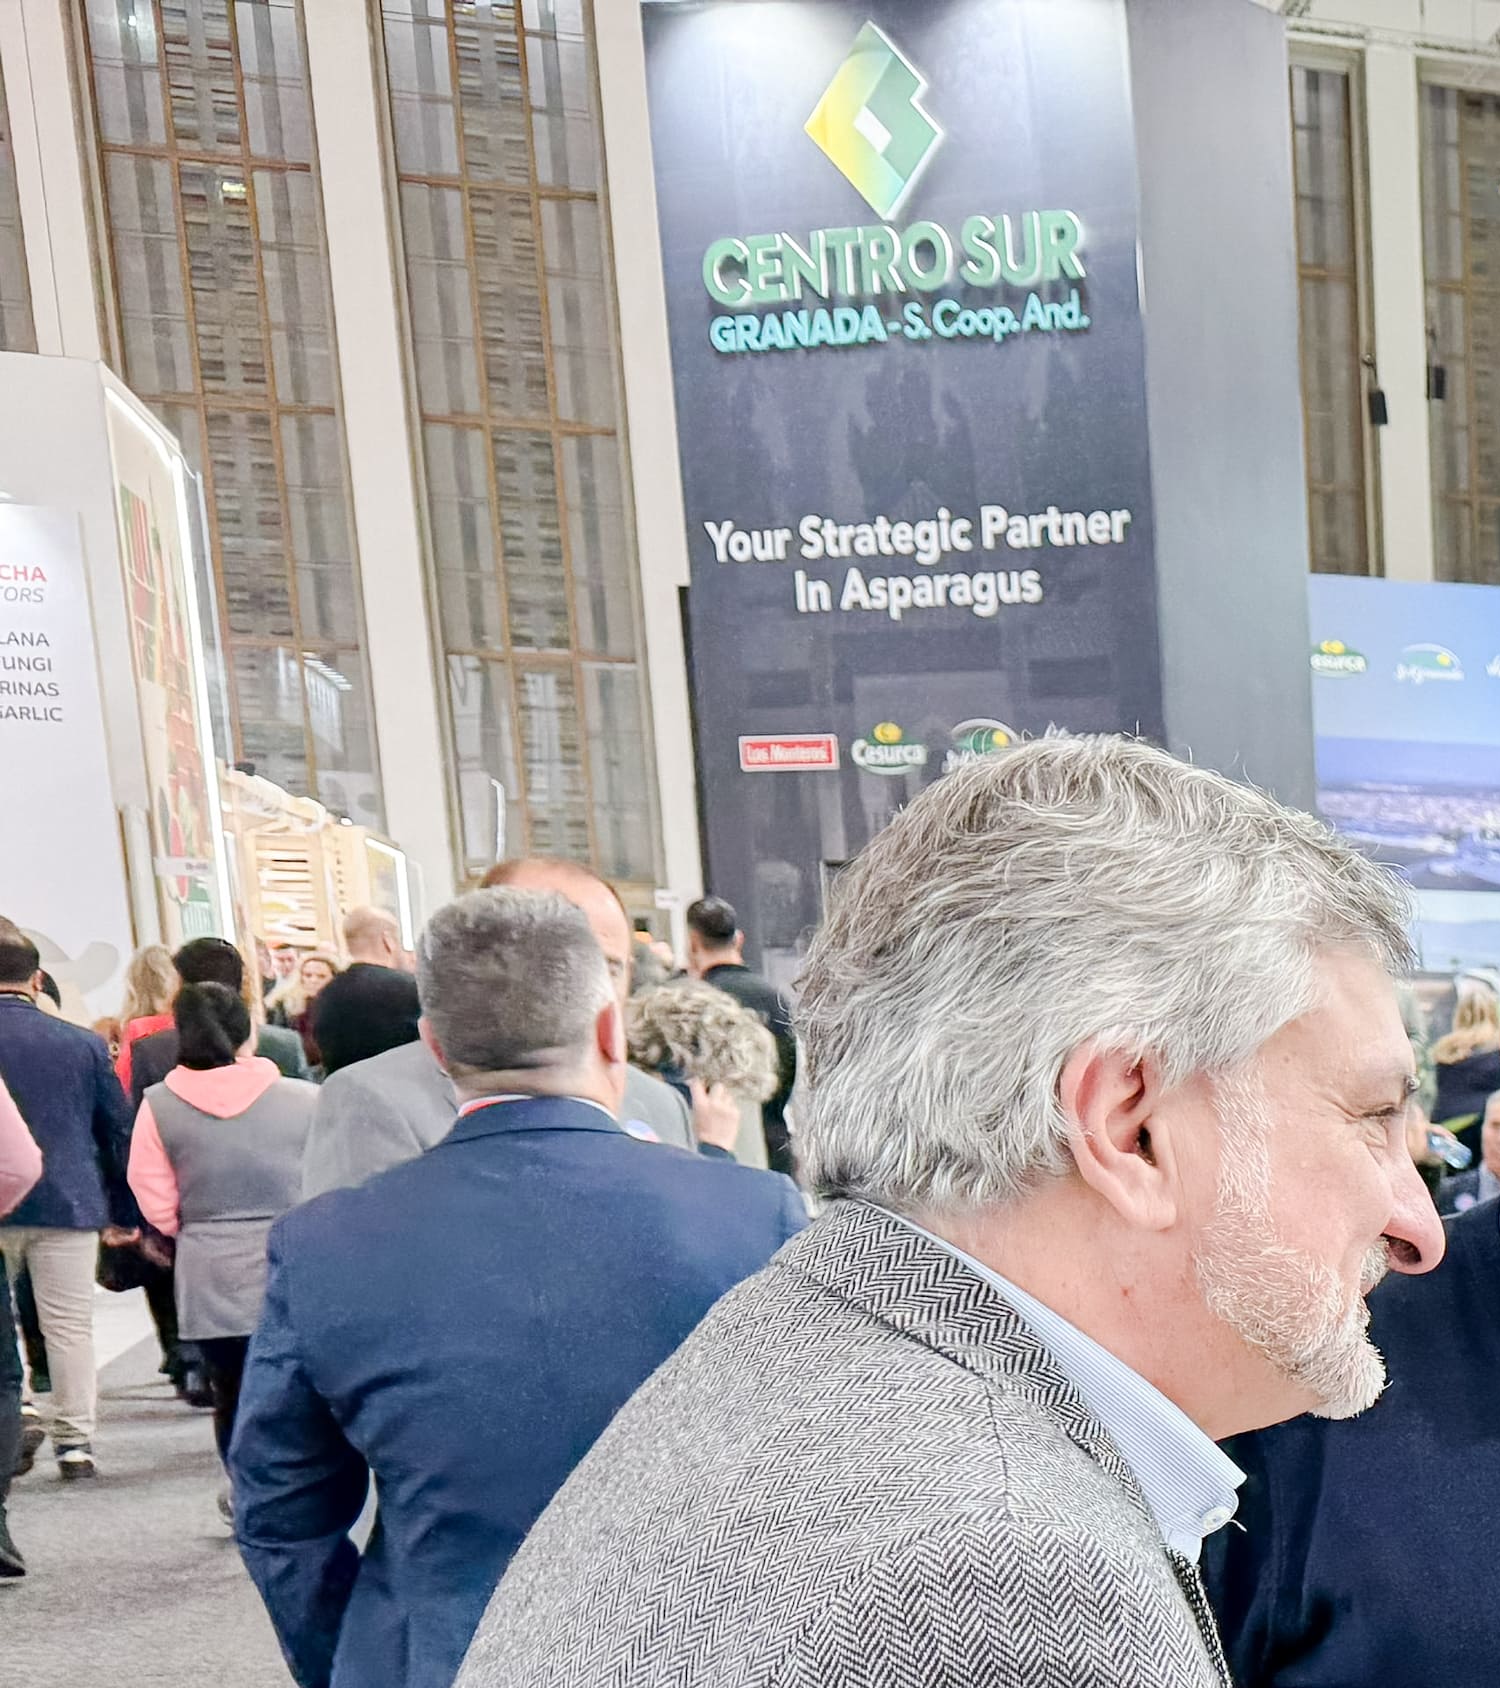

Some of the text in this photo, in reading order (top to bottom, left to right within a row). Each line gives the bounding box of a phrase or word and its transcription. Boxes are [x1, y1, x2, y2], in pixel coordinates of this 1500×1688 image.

[703, 210, 1087, 307] CENTRO SUR
[703, 505, 1132, 566] Your Strategic Partner
[0, 586, 44, 603] ORS
[794, 567, 1043, 621] In Asparagus
[0, 656, 52, 673] UNGI
